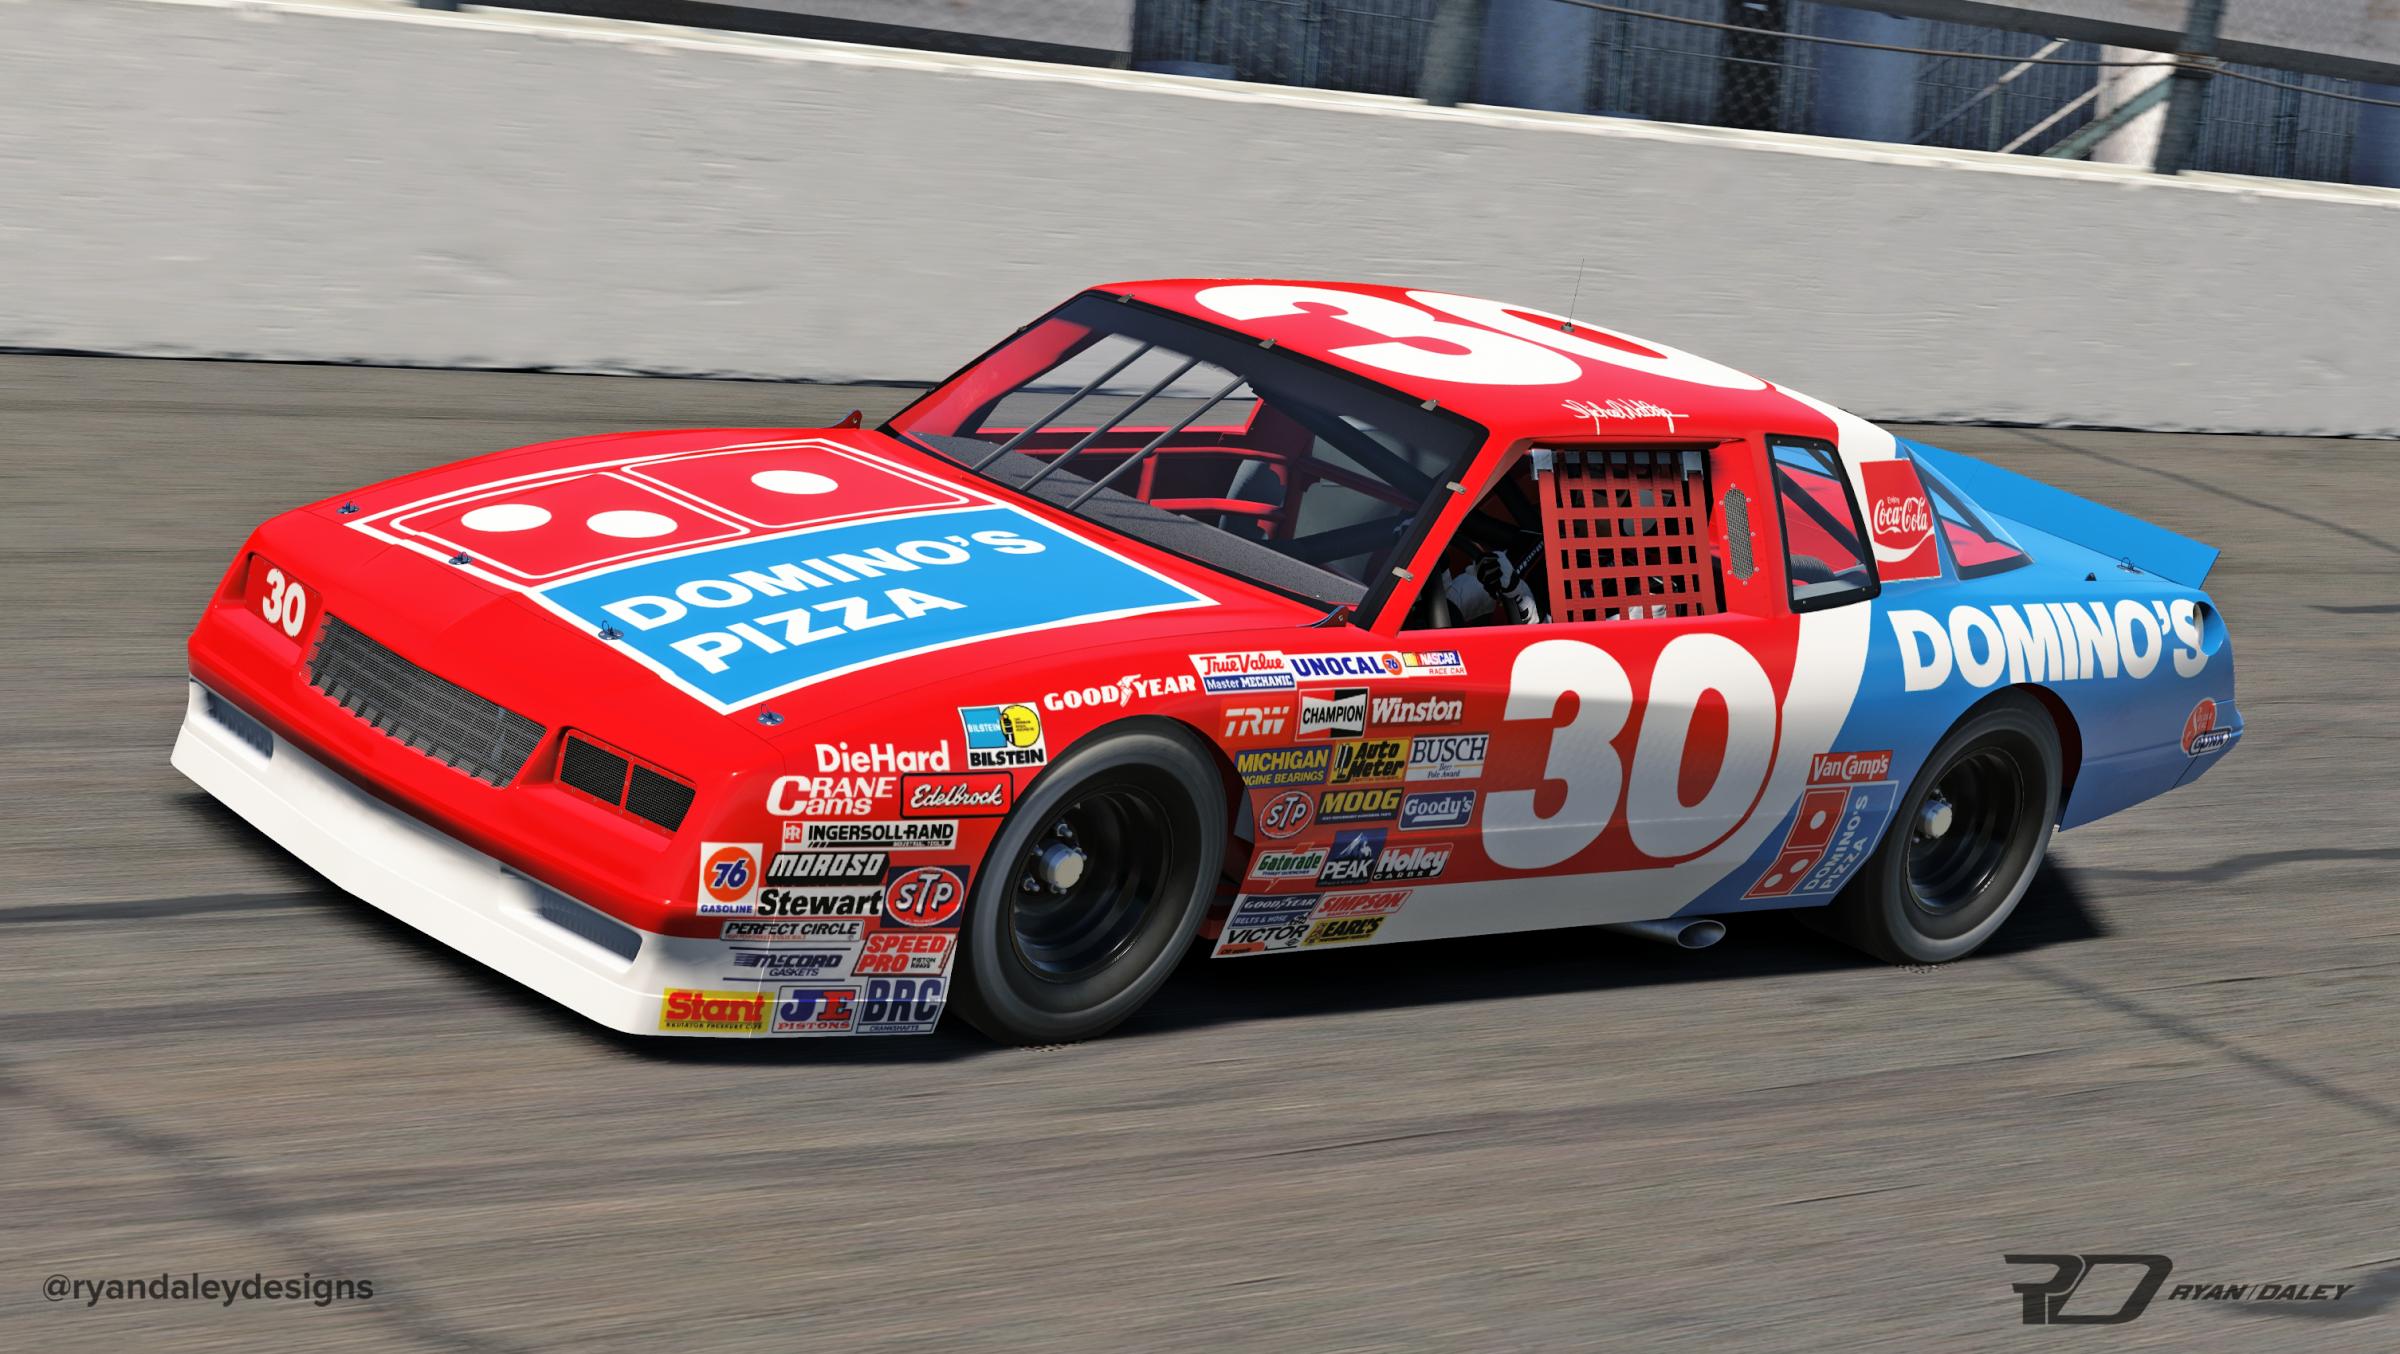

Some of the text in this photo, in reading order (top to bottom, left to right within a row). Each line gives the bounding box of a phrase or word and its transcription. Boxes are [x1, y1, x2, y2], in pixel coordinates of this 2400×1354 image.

[1195, 284, 1767, 391] 30
[1873, 496, 1929, 535] Coca-Cola
[601, 529, 1047, 631] DOMINO'S
[262, 568, 306, 638] 30
[669, 586, 967, 675] PIZZA
[1887, 598, 2210, 692] DOMINO'S
[1291, 656, 1399, 676] UNOCAL 76
[1420, 650, 1460, 666] NASCAR
[1429, 666, 1464, 675] RACE CAR
[1207, 674, 1293, 690] Master MECHANIC
[1225, 706, 1290, 737] TRW
[1302, 704, 1364, 725] CHAMPION
[1371, 696, 1463, 724] Winston
[967, 722, 1001, 733] BILSTEIN
[814, 739, 951, 773] DieHard
[970, 748, 1045, 767] BILSTEIN
[1237, 748, 1330, 773] MICHIGAN
[1357, 740, 1400, 759] Auto
[1410, 737, 1488, 764] BUSCH
[1482, 632, 1777, 869] 30
[1242, 770, 1324, 786] NGINE BEARINGS
[1350, 758, 1405, 778] Meter
[910, 783, 1004, 809] Edelbrock
[1320, 788, 1403, 814] MOOG
[1266, 796, 1307, 829] STP
[1404, 796, 1472, 823] Goody's
[808, 824, 954, 841] INGERSOLL-RAND
[1803, 795, 1869, 890] DOMINO'S
[711, 857, 750, 888] 76
[768, 853, 883, 878] MOROSO
[1258, 852, 1323, 871] Gatorade
[1319, 858, 1375, 880] PEAK
[1377, 847, 1451, 876] Holley
[1819, 836, 1869, 889] PIZZA
[757, 888, 883, 916] Stewart
[895, 873, 954, 917] STP
[1317, 892, 1404, 913] SIMPSON
[700, 903, 753, 914] GASOLINE
[1236, 915, 1260, 924] BELTS
[1268, 914, 1288, 922] HOSE
[725, 922, 859, 935] PERFECT CIRCLE
[1227, 925, 1310, 944] VICTOR
[1322, 917, 1385, 938] EARL'S
[866, 935, 947, 953] SPEED
[769, 967, 820, 977] GASKETS
[856, 953, 910, 973] PRO
[665, 991, 764, 1022] Stant
[780, 988, 857, 1022] JE
[862, 979, 942, 1023] BRC
[776, 1021, 850, 1031] PISTONS
